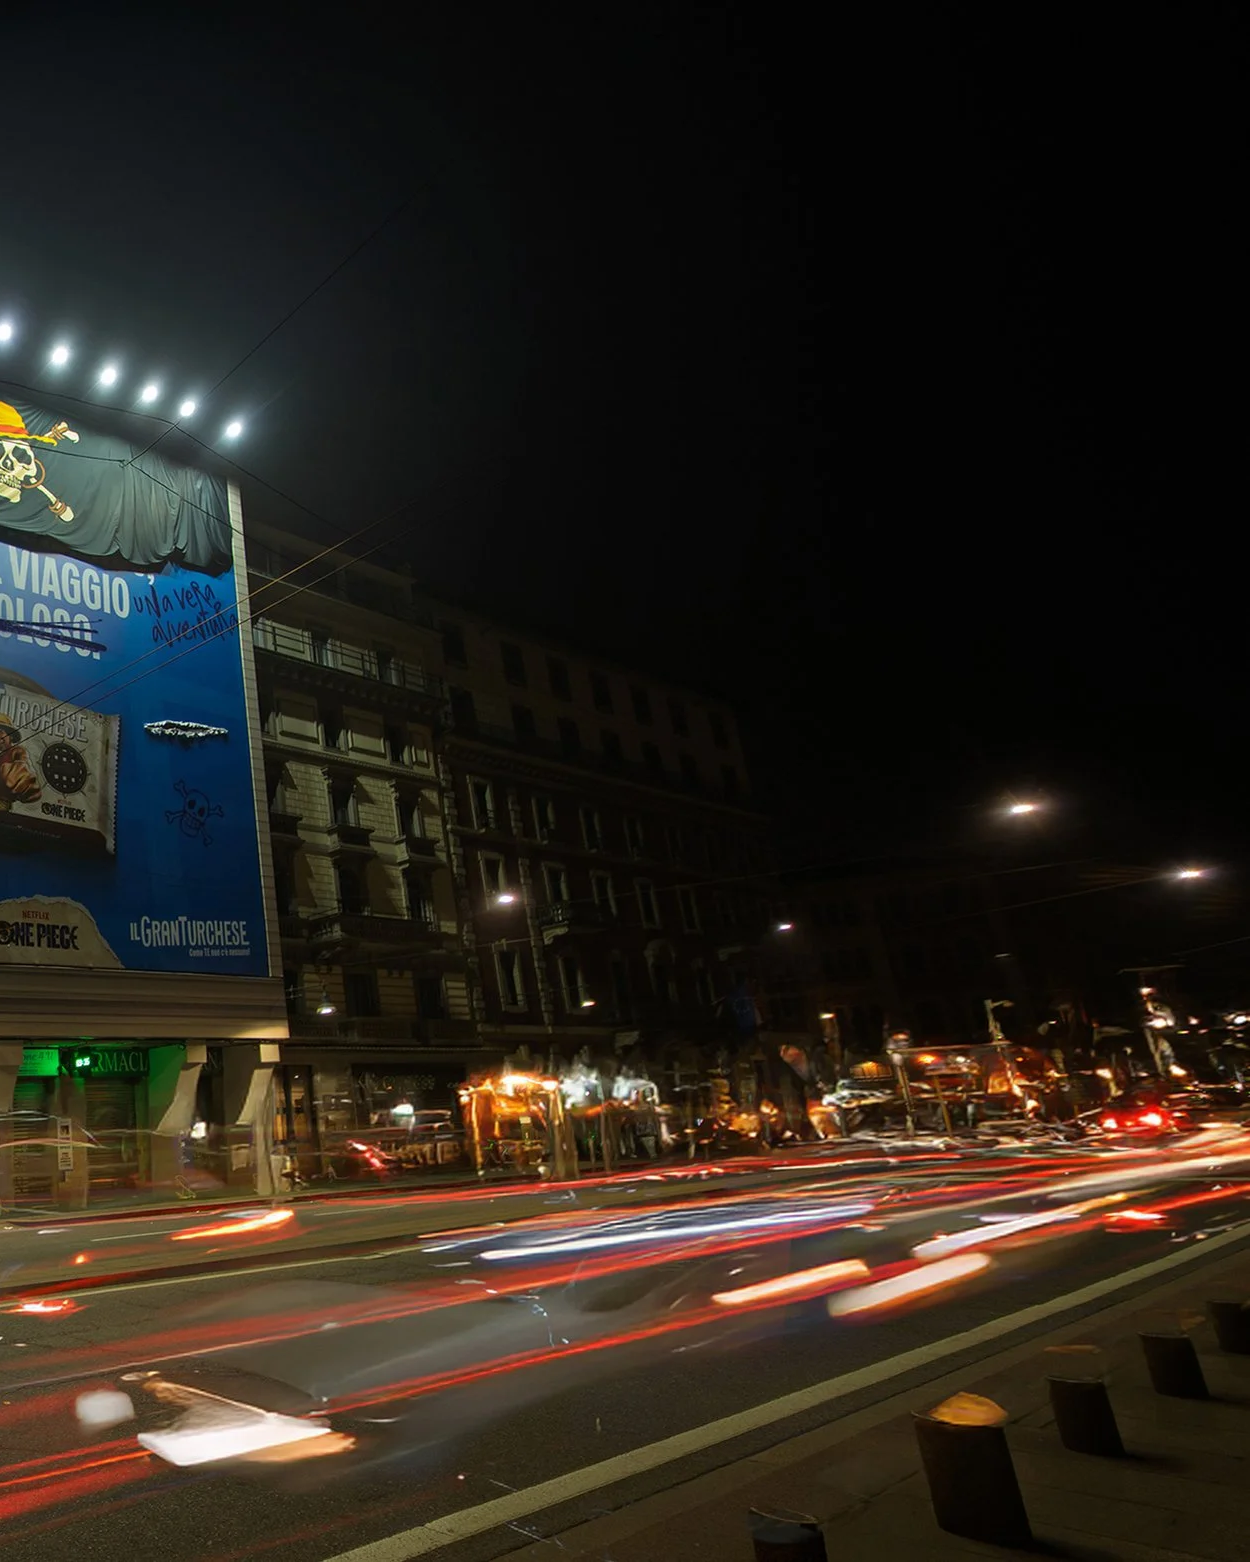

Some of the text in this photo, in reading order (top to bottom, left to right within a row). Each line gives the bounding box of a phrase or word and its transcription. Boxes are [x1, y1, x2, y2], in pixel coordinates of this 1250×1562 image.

[9, 546, 130, 618] VIAGGIO
[22, 911, 49, 920] NETFLIX
[36, 923, 79, 950] PIECE
[131, 922, 141, 941] IL
